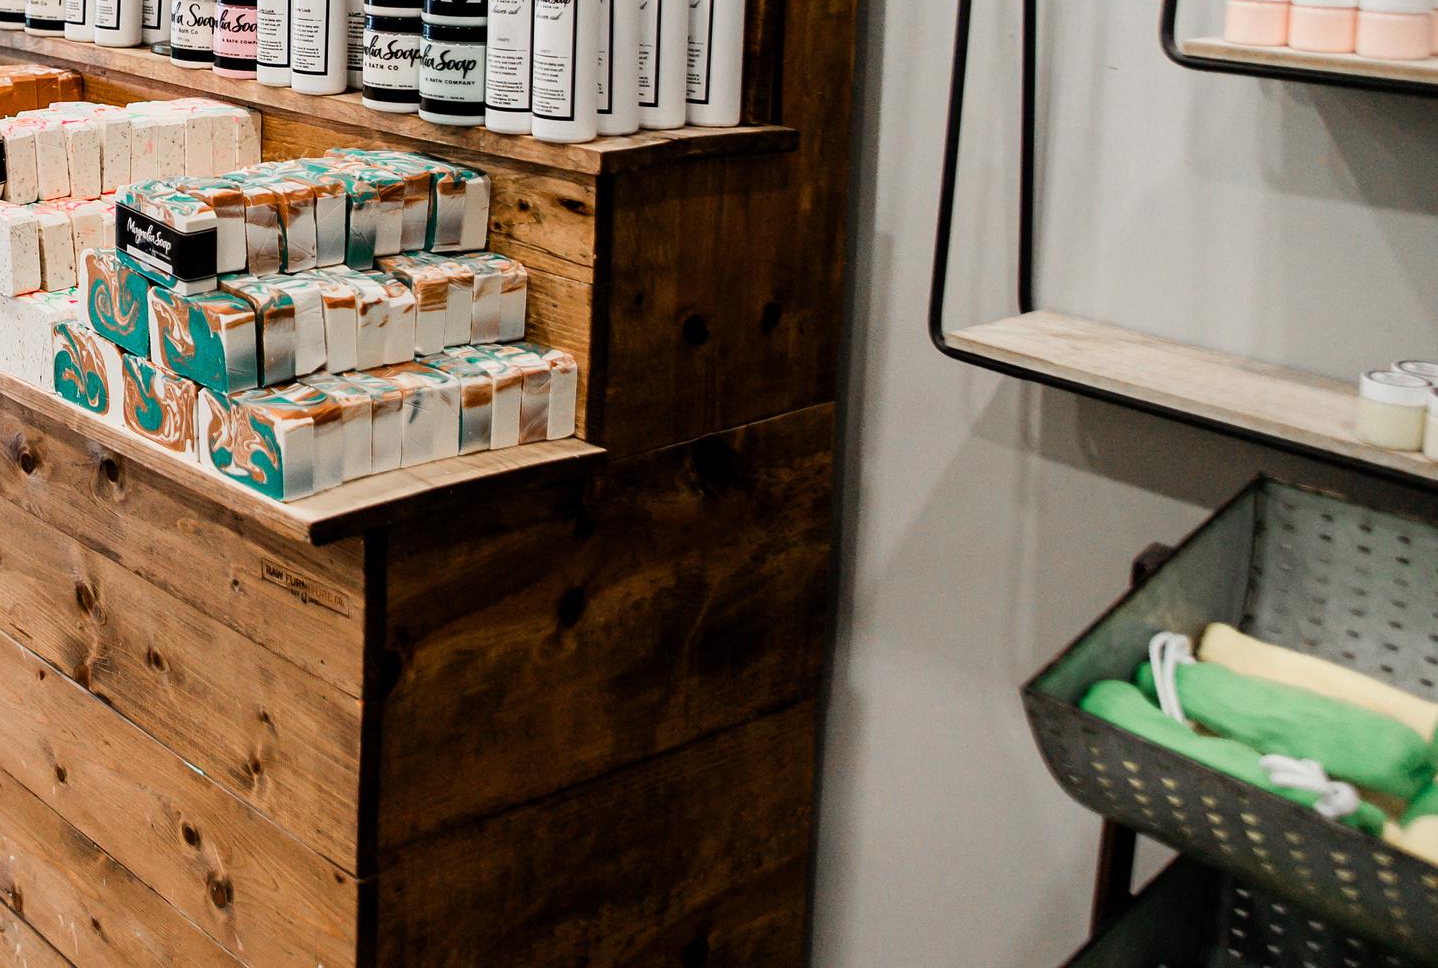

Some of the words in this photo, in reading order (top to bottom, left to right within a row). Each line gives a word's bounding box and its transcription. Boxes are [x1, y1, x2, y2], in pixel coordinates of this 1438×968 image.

[187, 3, 215, 35] Soap
[232, 14, 257, 33] Soa
[382, 40, 422, 68] Soap
[435, 49, 477, 79] Soap
[126, 216, 156, 244] Magnolia
[154, 231, 172, 255] Soap
[265, 564, 284, 581] RAW
